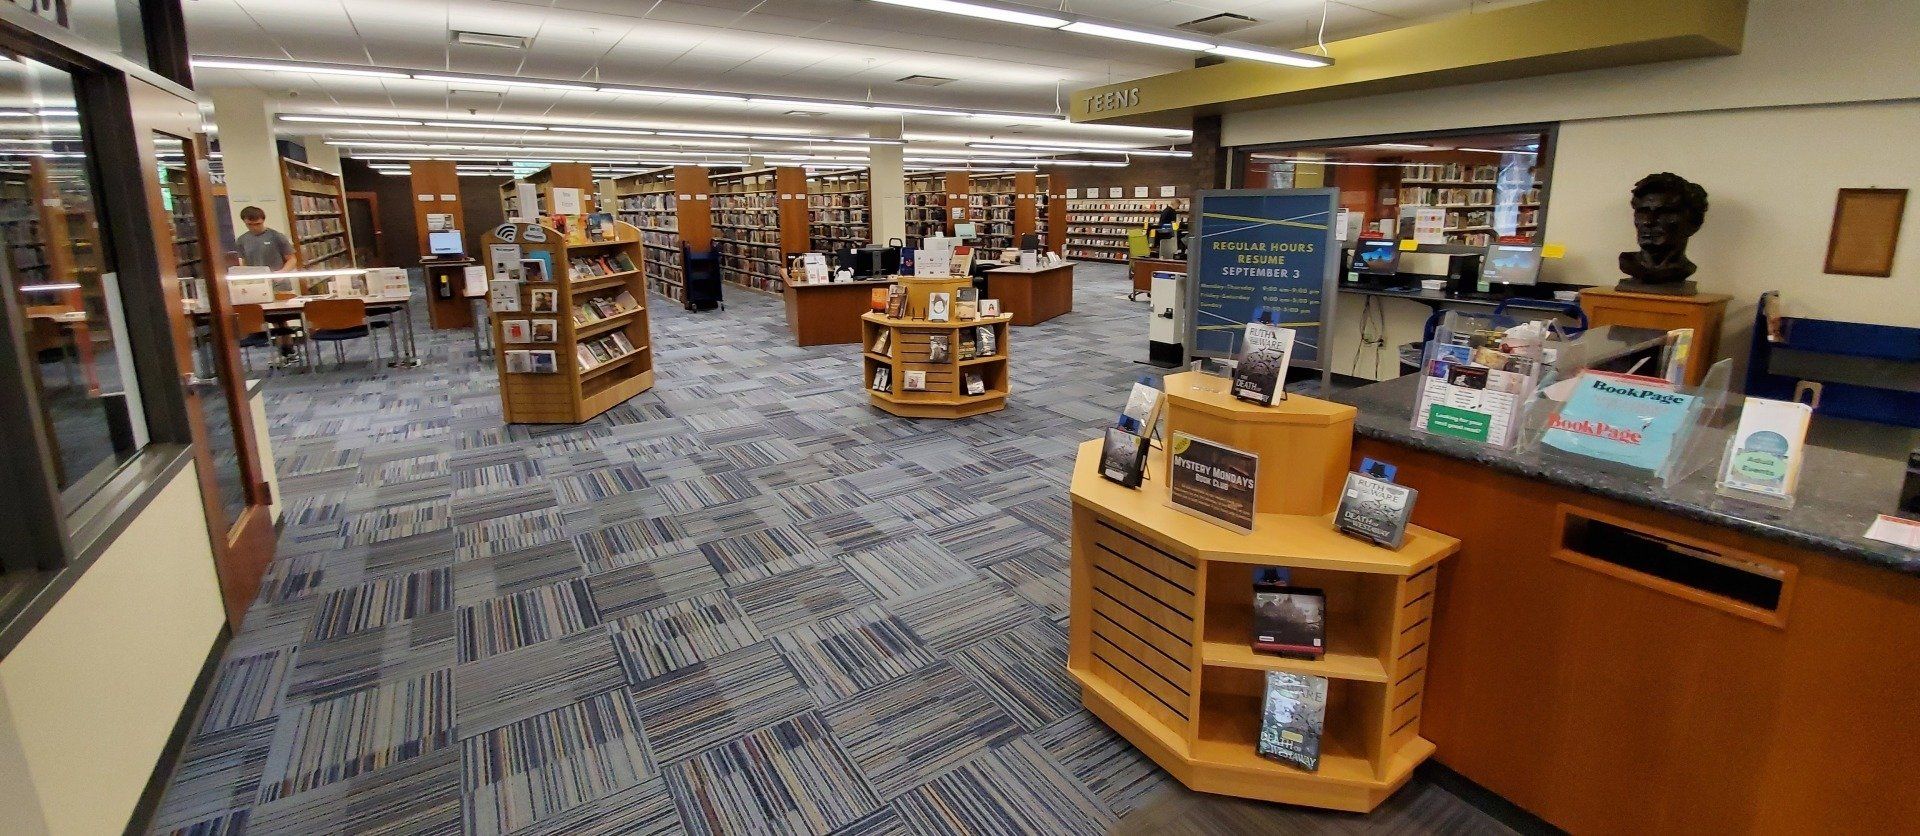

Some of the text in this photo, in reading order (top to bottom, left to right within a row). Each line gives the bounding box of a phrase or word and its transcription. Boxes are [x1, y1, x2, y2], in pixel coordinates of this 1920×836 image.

[1083, 88, 1139, 113] TEENS
[1212, 241, 1314, 253] REGULAR HOURS
[1238, 254, 1285, 265] RESUME
[1222, 266, 1300, 278] SEPTEMBER 3
[1250, 327, 1271, 339] RUTH
[1260, 337, 1282, 349] WARE
[1236, 379, 1257, 390] DEATH
[1593, 380, 1684, 405] BookPage
[1548, 412, 1642, 444] BookPage
[1747, 457, 1774, 466] Adult
[1174, 455, 1254, 489] MYSTERY MONDAYS
[1742, 465, 1775, 476] Events
[1357, 479, 1384, 492] RUTH
[1371, 490, 1399, 503] WARE
[1344, 511, 1373, 524] DEATH
[1352, 521, 1390, 536] WESTAWAY
